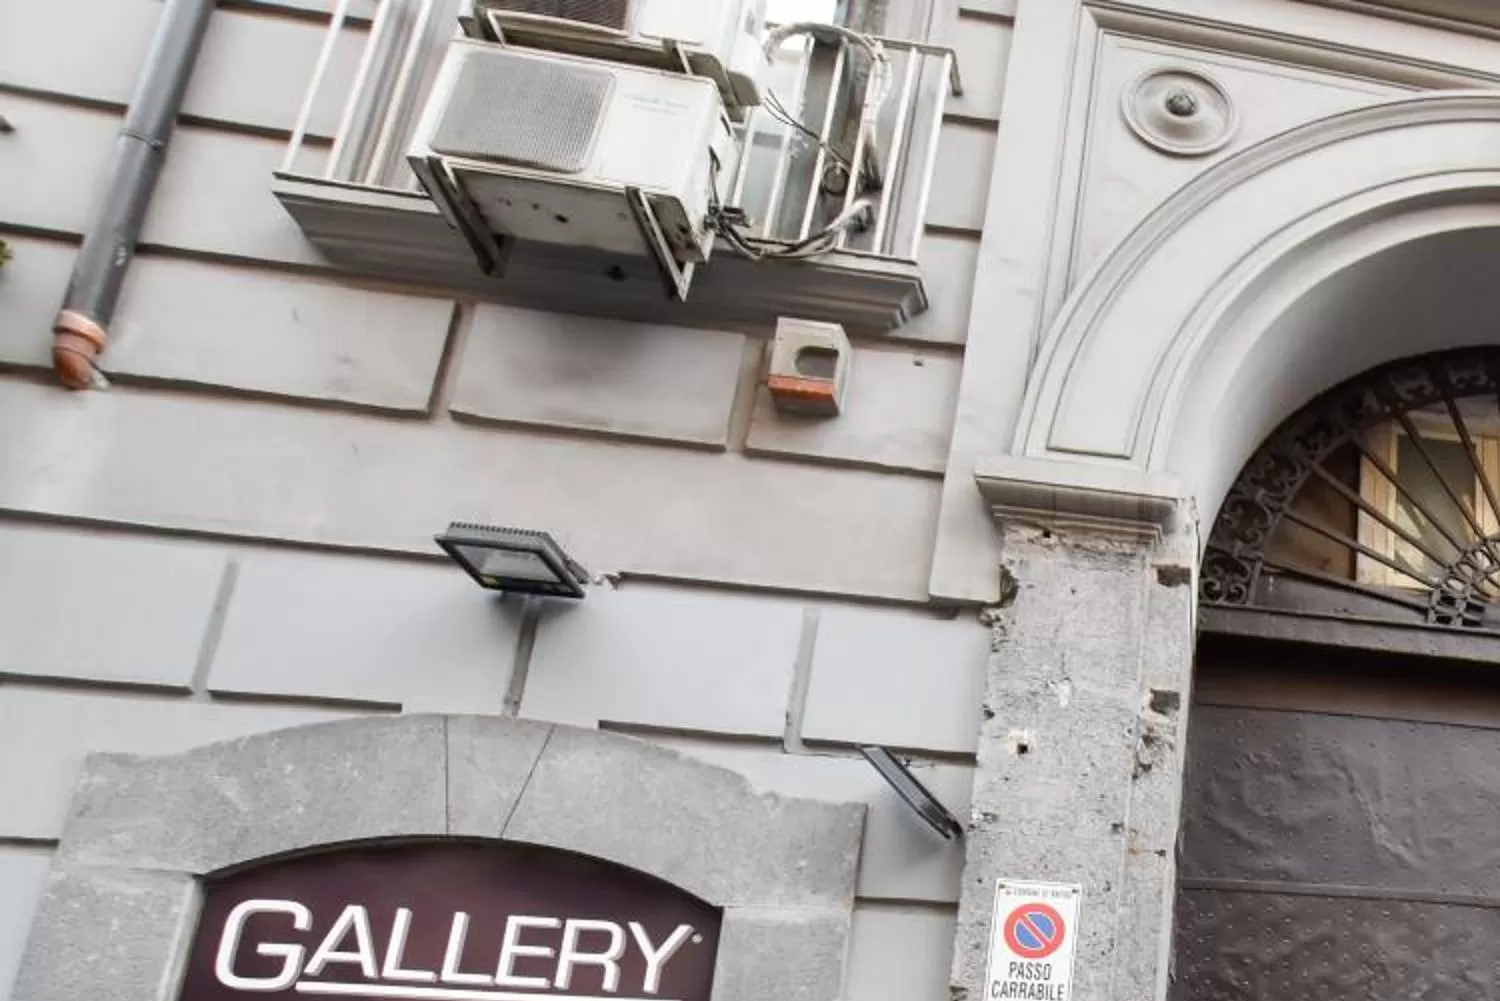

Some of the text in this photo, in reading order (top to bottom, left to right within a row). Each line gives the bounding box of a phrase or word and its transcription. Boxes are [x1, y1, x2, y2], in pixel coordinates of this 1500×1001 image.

[215, 898, 696, 994] GALLERY
[1008, 961, 1052, 981] PASSO
[991, 979, 1065, 1001] CARRABILE
